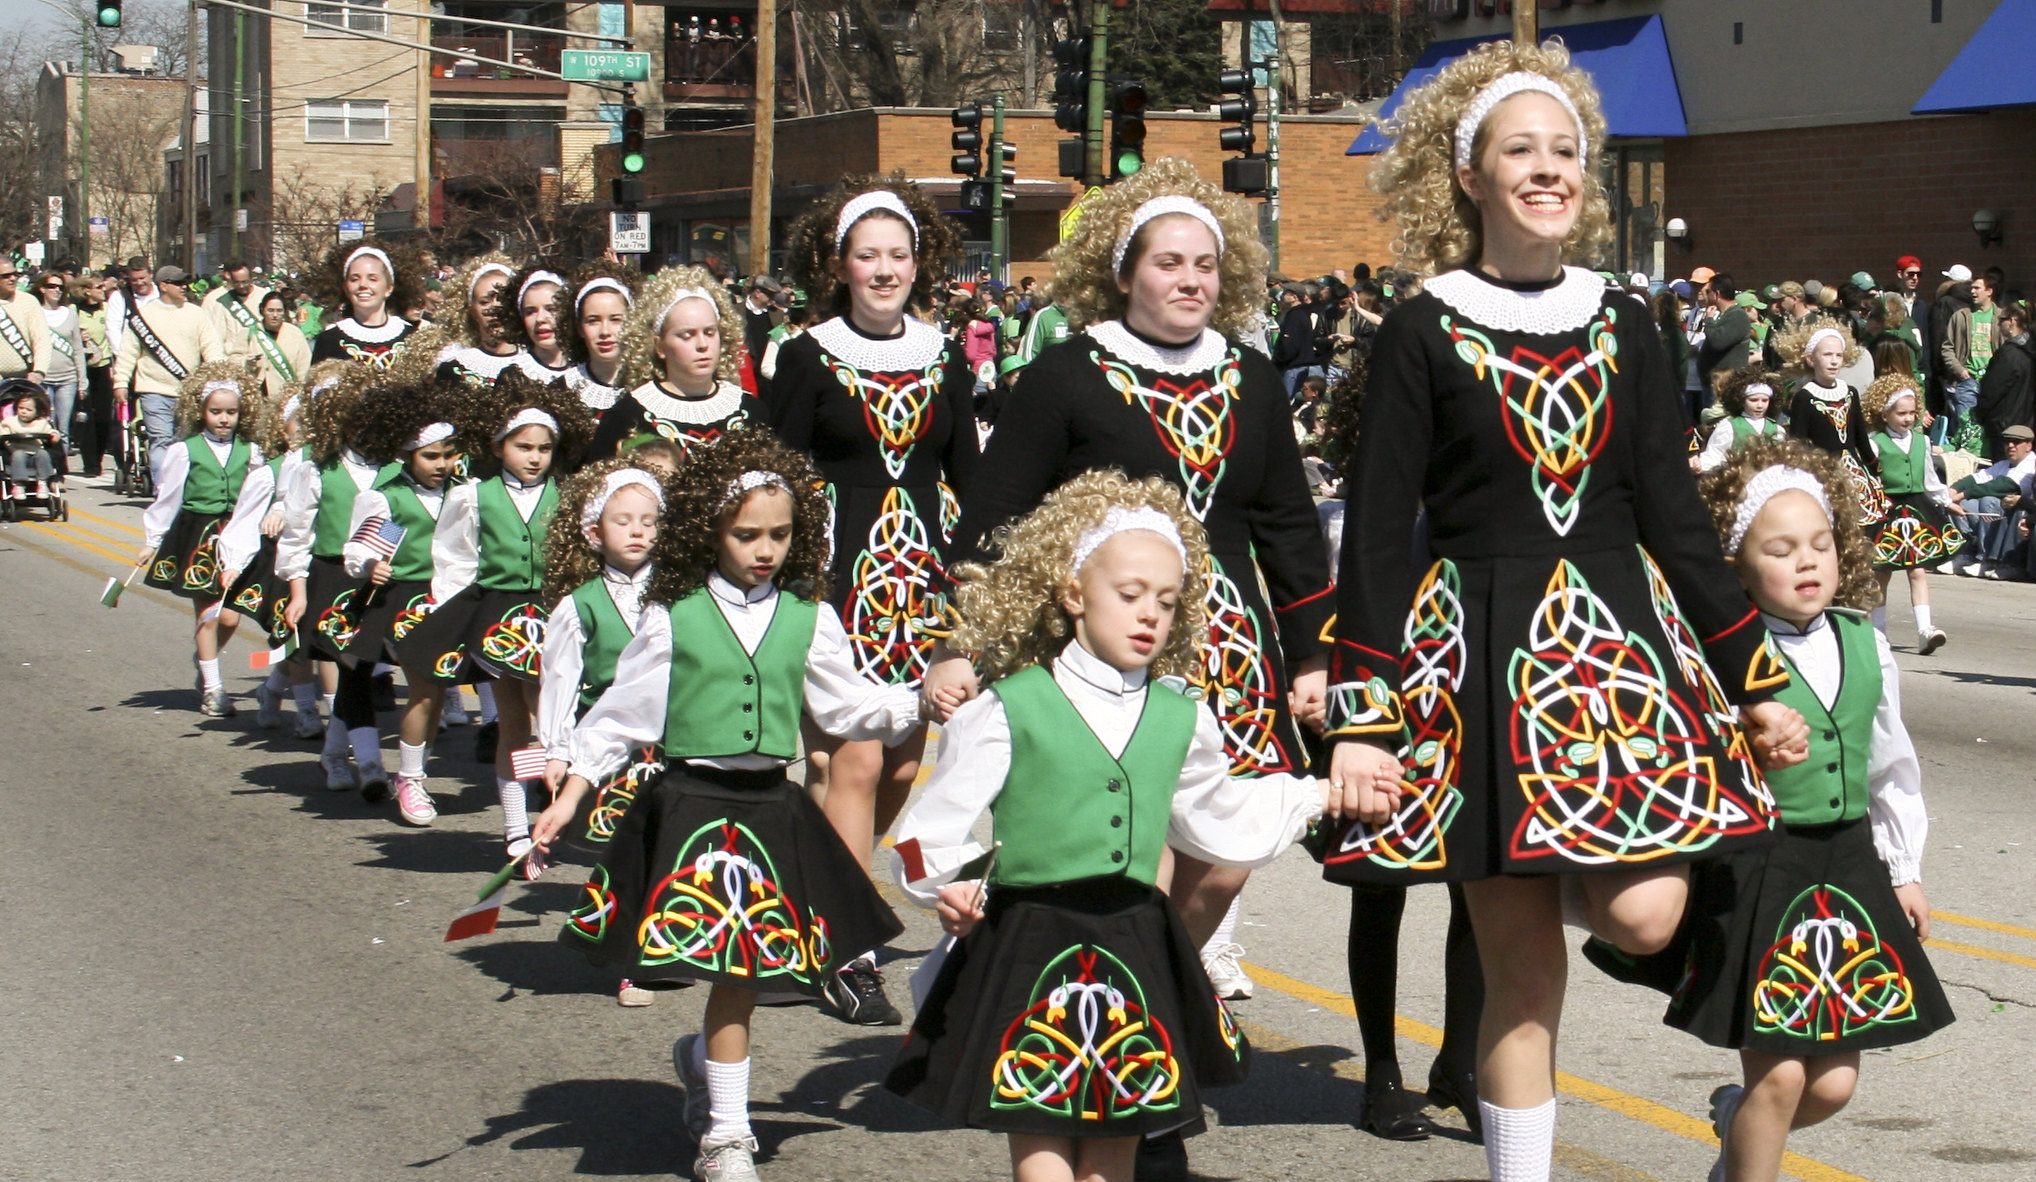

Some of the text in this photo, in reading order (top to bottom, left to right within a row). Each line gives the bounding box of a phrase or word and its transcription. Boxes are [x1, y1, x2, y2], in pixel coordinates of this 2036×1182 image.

[585, 55, 618, 67] 109TH
[626, 57, 641, 68] ST
[619, 69, 625, 77] S
[619, 223, 641, 231] TURN
[615, 232, 646, 240] ON RED
[230, 300, 255, 326] TRI
[131, 315, 187, 377] MEN OF TRINITY
